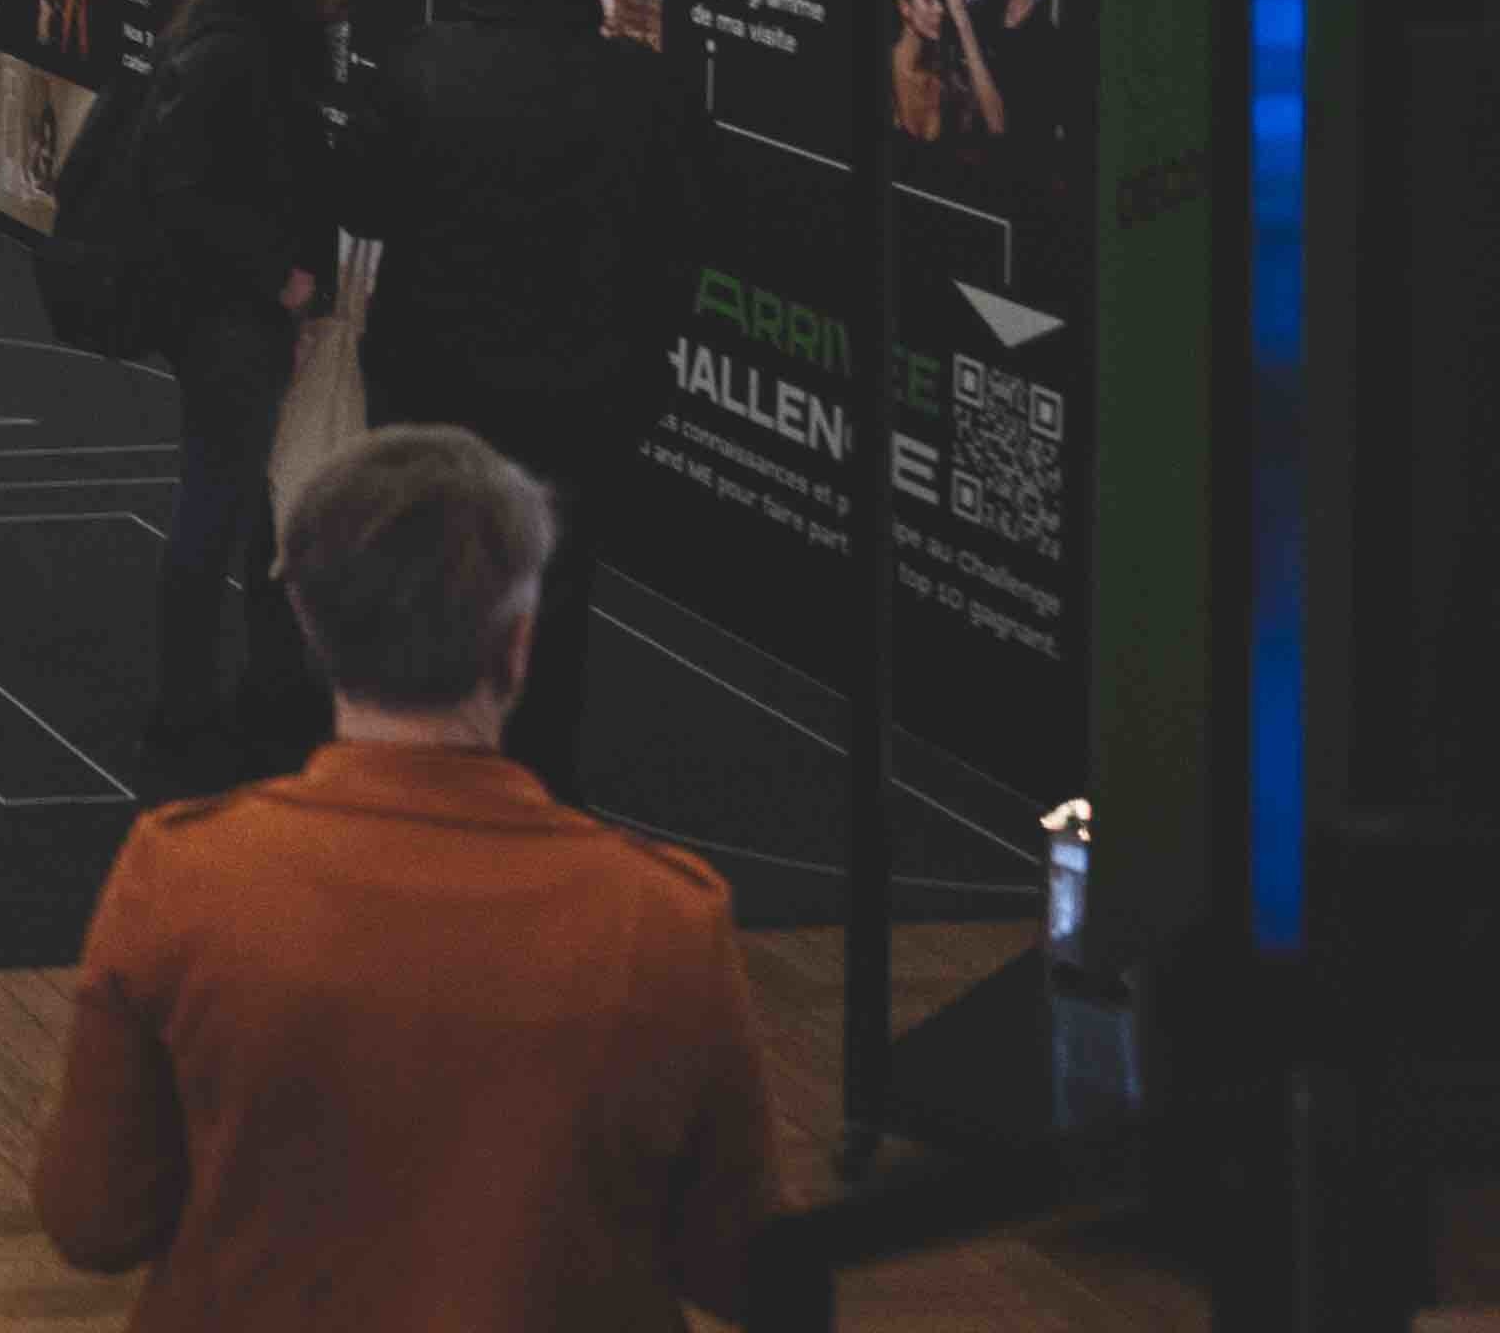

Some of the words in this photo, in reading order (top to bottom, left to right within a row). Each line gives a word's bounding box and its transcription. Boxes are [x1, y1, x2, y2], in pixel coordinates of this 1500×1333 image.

[691, 4, 713, 27] de
[716, 13, 746, 37] ma
[749, 23, 798, 53] visite
[682, 420, 808, 496] connaissances
[812, 483, 832, 506] et
[717, 476, 753, 507] pour
[761, 493, 804, 531] faire
[808, 520, 848, 554] part
[936, 583, 965, 610] 10
